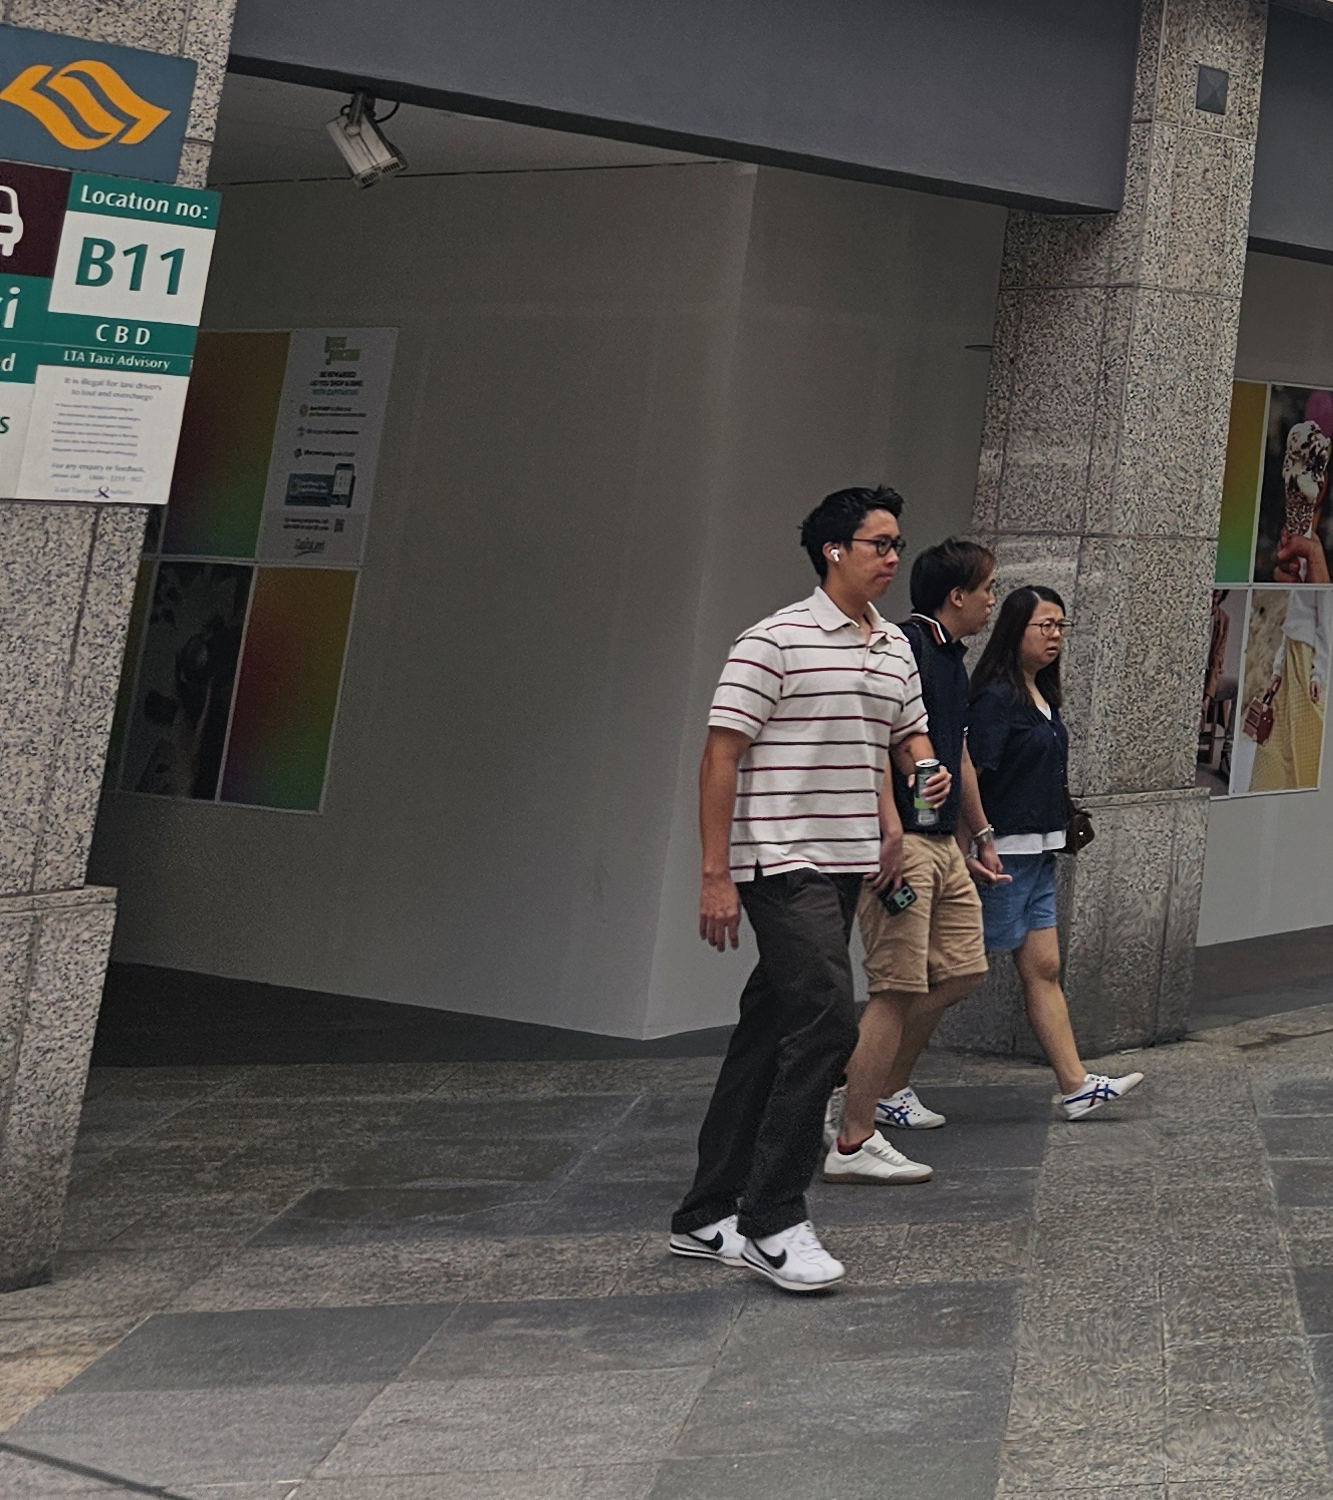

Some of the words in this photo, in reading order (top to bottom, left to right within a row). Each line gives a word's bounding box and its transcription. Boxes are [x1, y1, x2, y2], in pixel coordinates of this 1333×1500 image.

[80, 184, 170, 214] Location
[175, 201, 209, 220] no:
[75, 236, 186, 296] B11
[63, 350, 85, 362] LTA
[89, 352, 115, 365] Taxi
[116, 355, 171, 370] Advisory
